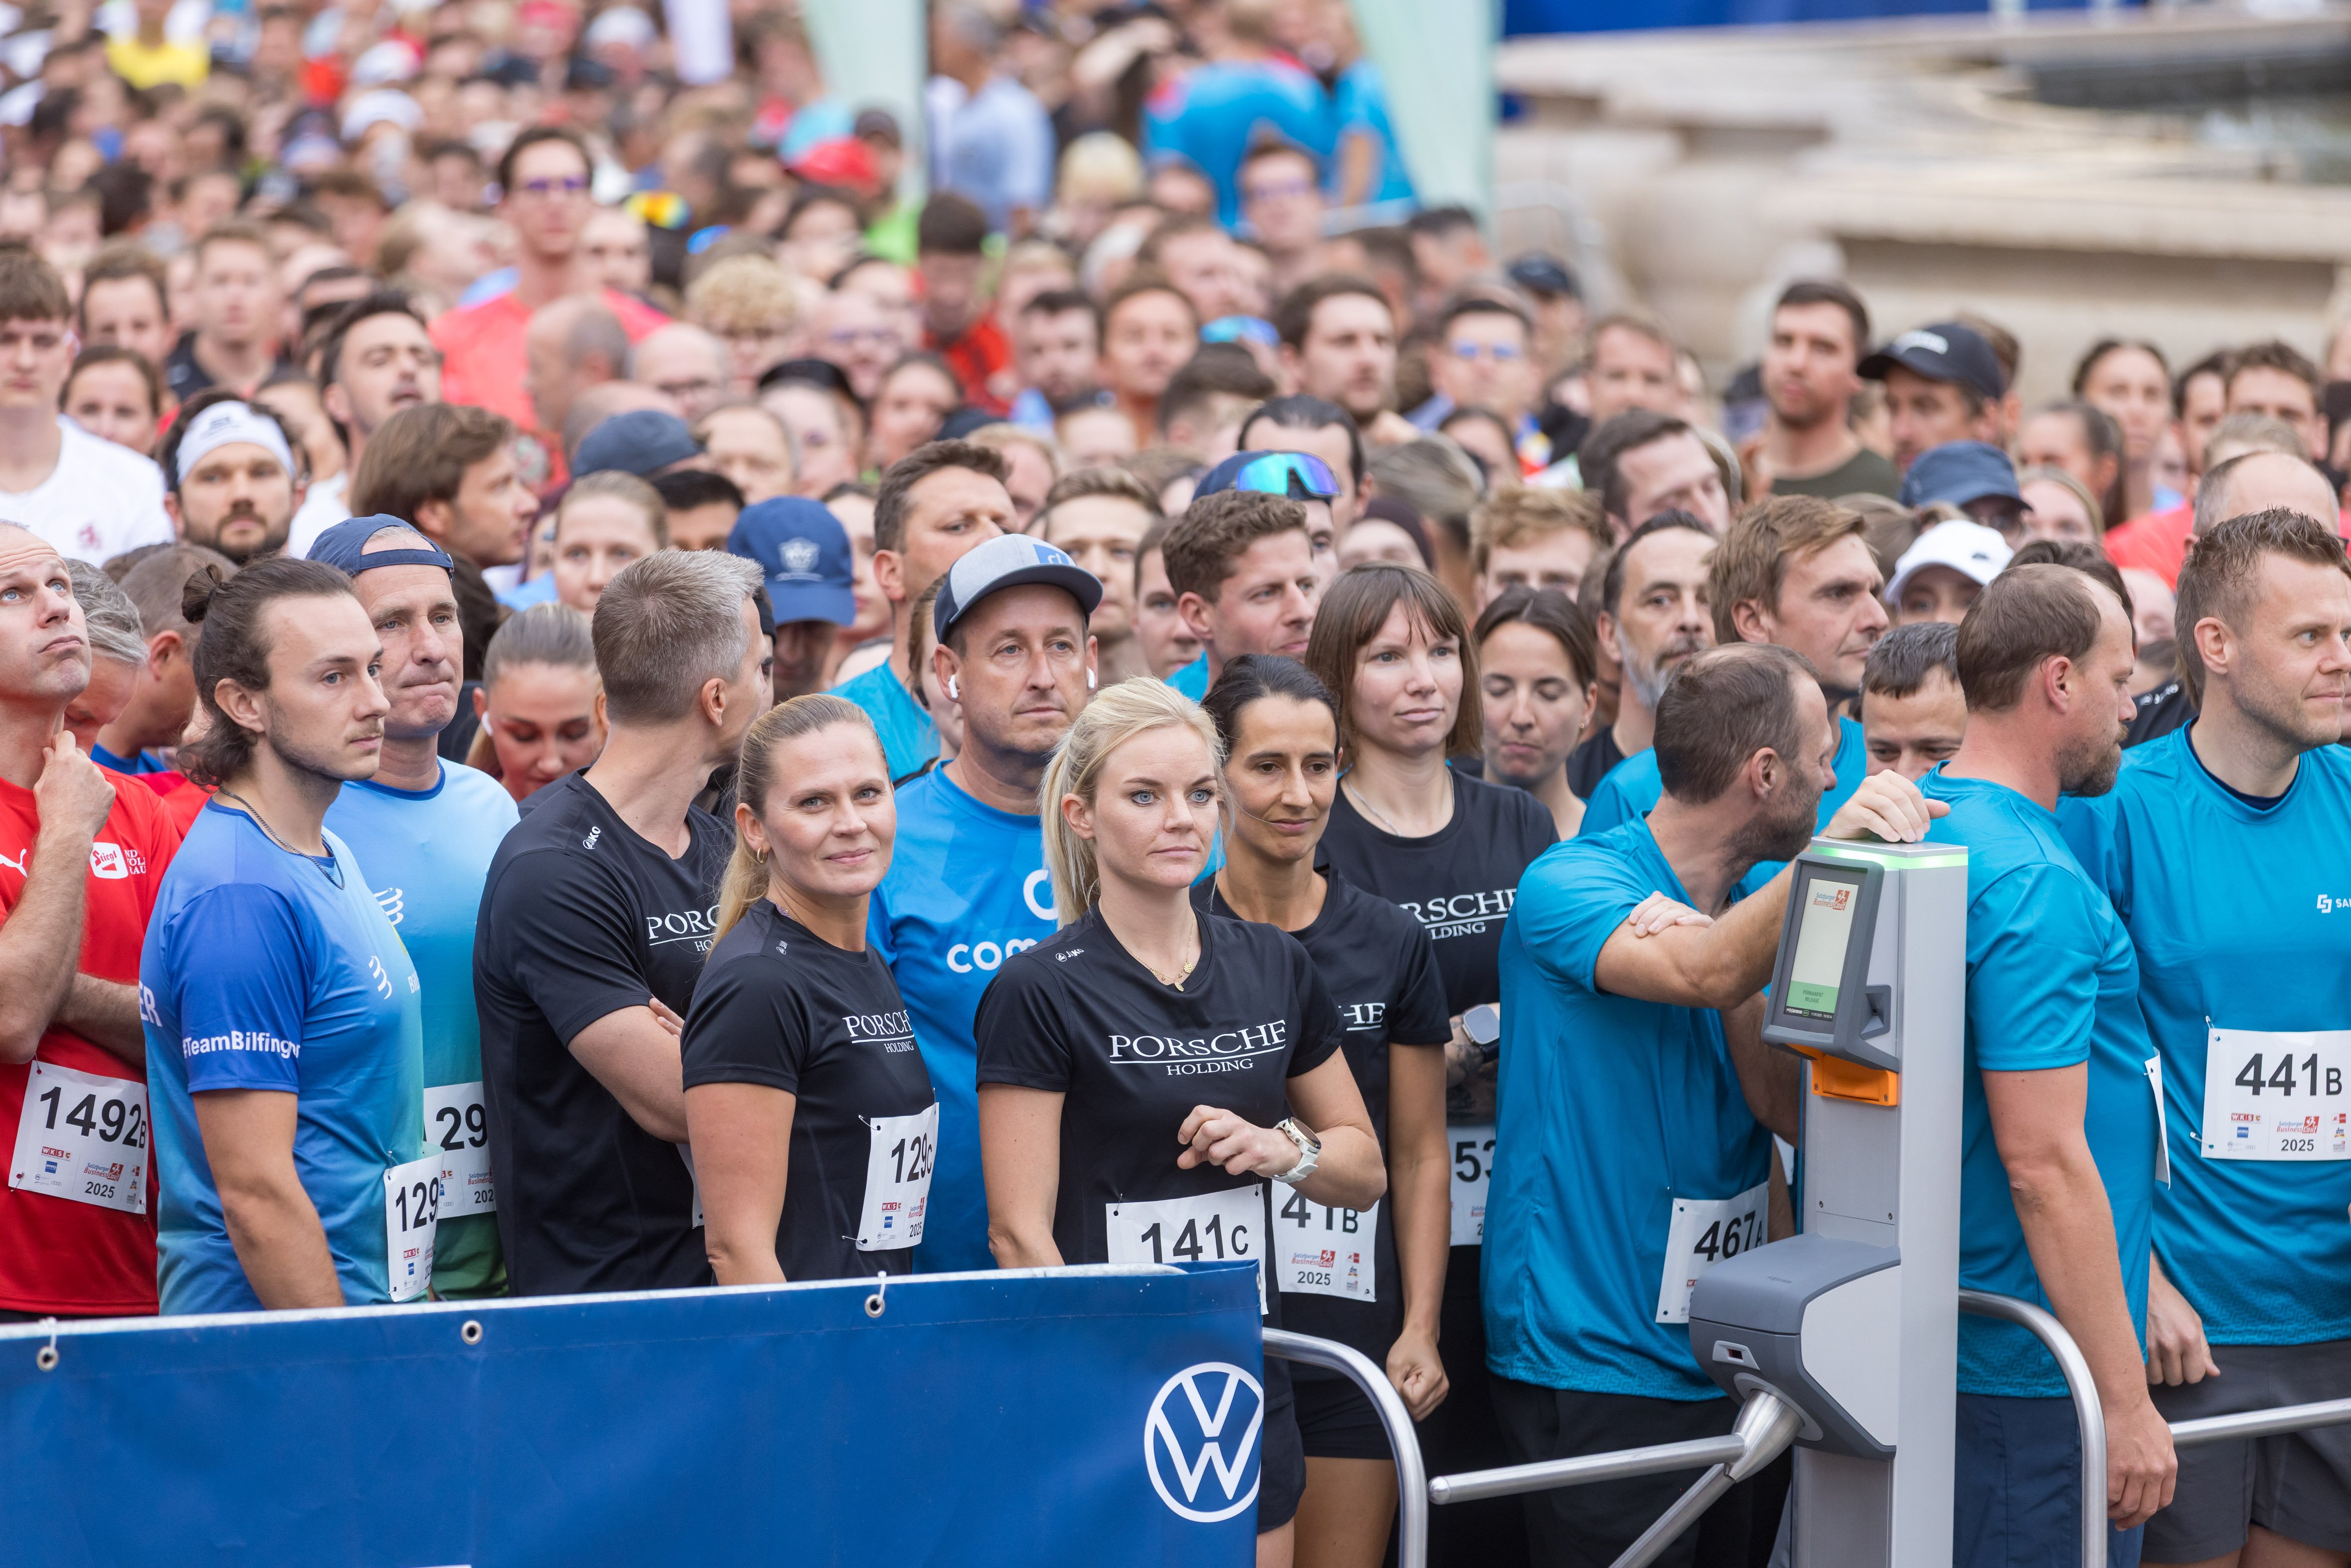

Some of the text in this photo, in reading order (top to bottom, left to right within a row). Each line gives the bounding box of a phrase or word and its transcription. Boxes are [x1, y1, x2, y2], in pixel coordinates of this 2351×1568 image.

[92, 850, 117, 867] Stiegl
[1816, 892, 1836, 901] Salzburger
[1813, 898, 1834, 908] Business
[1066, 948, 1084, 958] JAKO
[1108, 1019, 1286, 1058] PORSCHE
[883, 1041, 914, 1053] HOLDING
[1166, 1058, 1254, 1076] HOLDING
[2281, 1139, 2315, 1151] 2025
[42, 1147, 63, 1157] WKS
[84, 1167, 107, 1178] Business
[87, 1162, 110, 1172] Salzburger
[85, 1181, 115, 1199] 2025
[909, 1221, 922, 1238] 2025
[1291, 1257, 1319, 1266] Business
[1297, 1271, 1331, 1286] 2025
